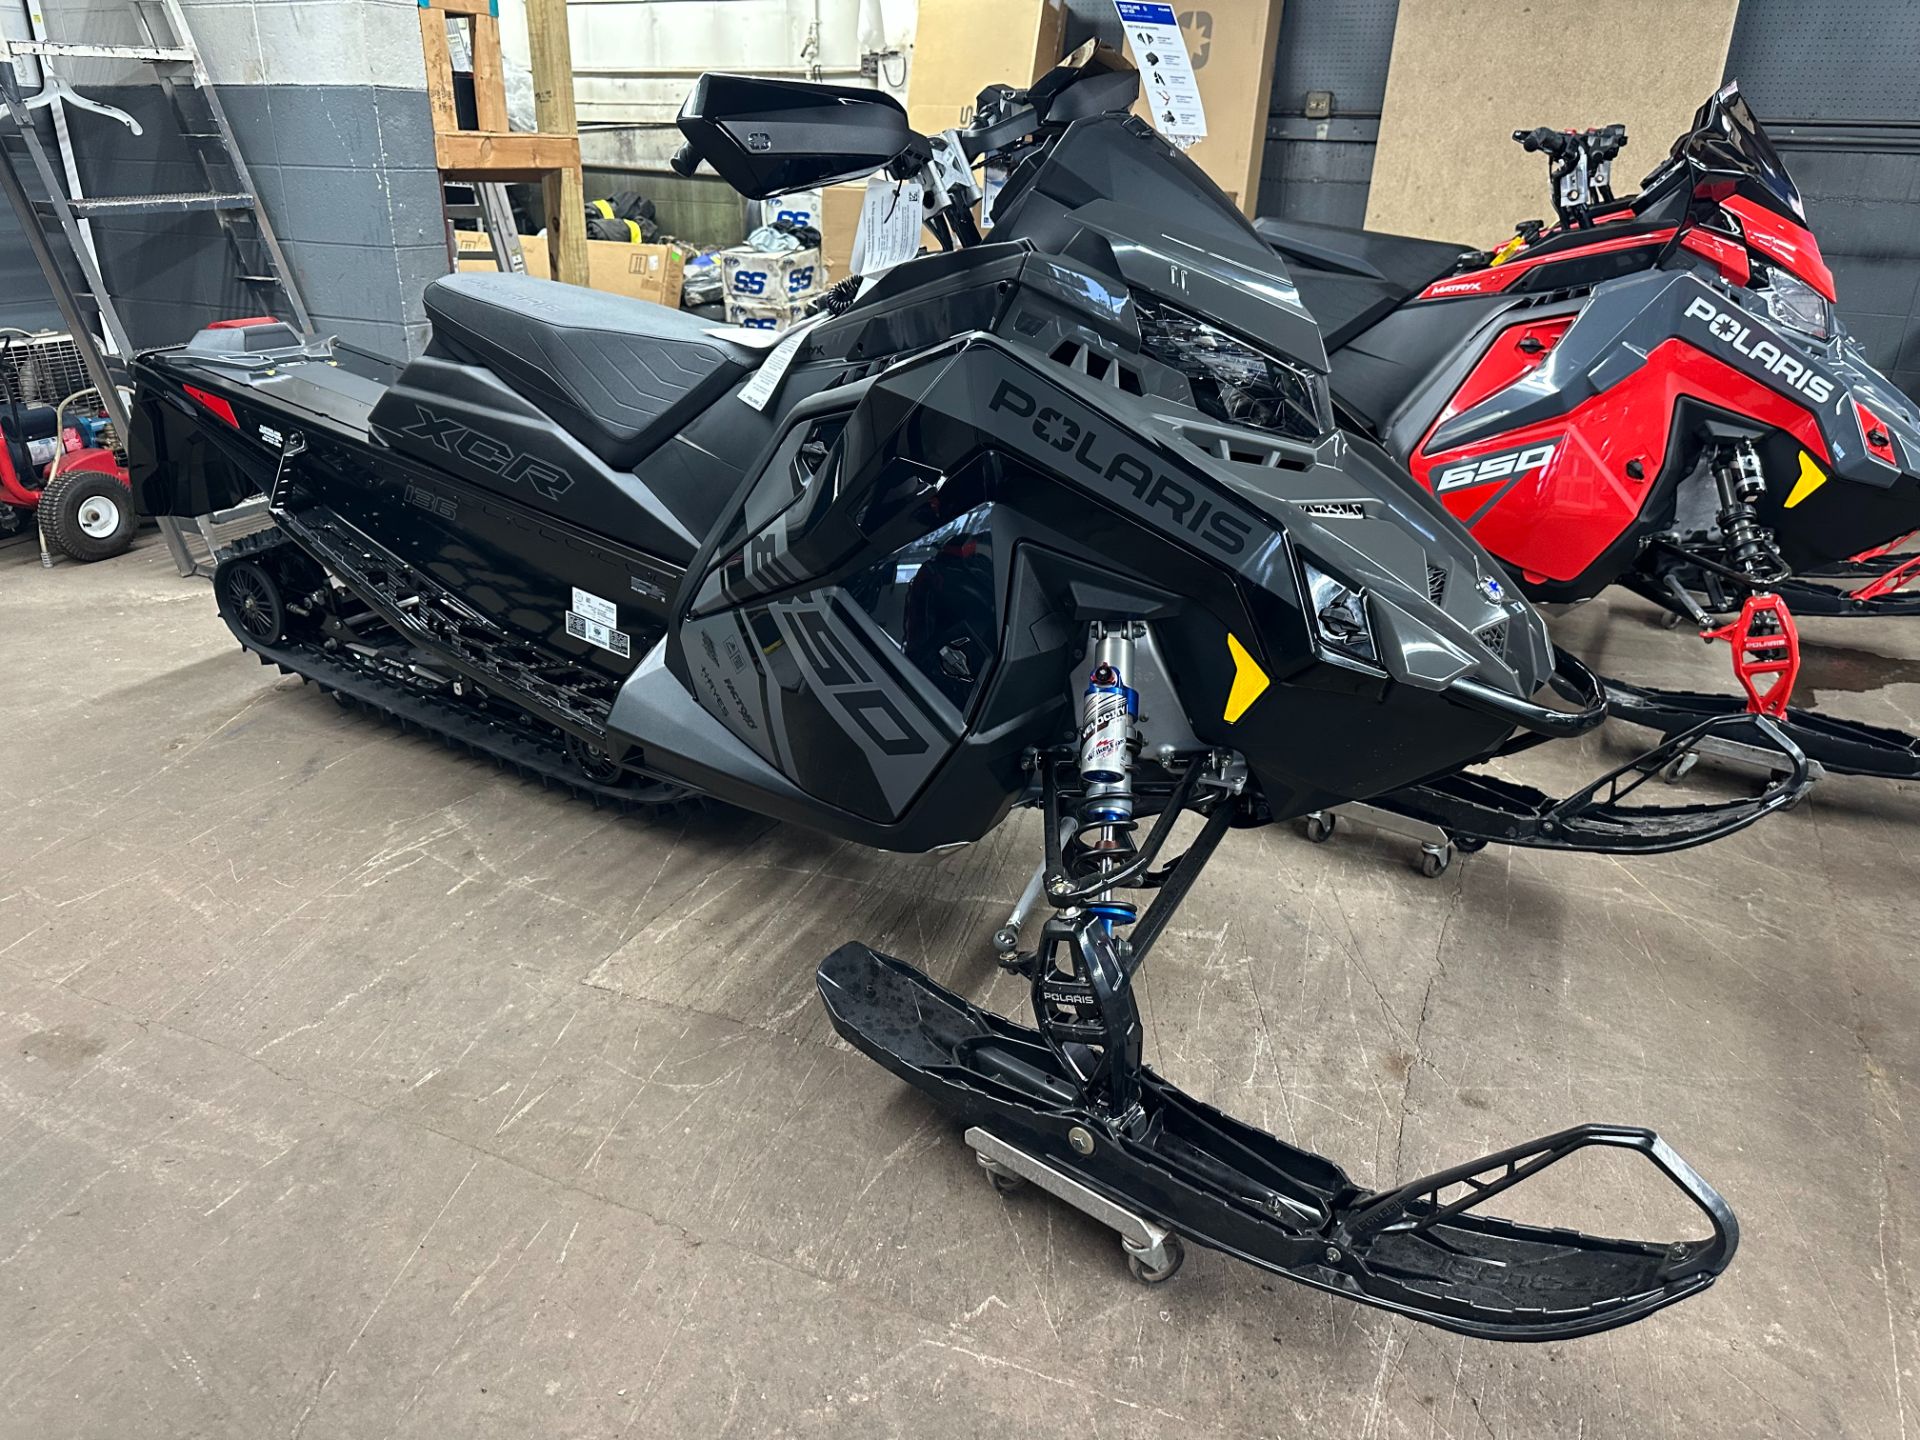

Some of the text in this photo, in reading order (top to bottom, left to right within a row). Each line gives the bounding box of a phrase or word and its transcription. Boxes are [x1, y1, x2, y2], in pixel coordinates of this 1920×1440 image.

[733, 270, 768, 295] SS
[788, 265, 815, 293] SS
[1431, 282, 1482, 296] MATRYX
[1683, 296, 1835, 404] POLARIS
[401, 404, 576, 502] XCR
[988, 378, 1253, 556] POLARIS
[1437, 444, 1557, 492] 650
[403, 484, 459, 521] 136
[1745, 639, 1786, 649] POLARIS
[1083, 706, 1126, 738] VELOCITY
[1043, 991, 1095, 1005] POLARIS
